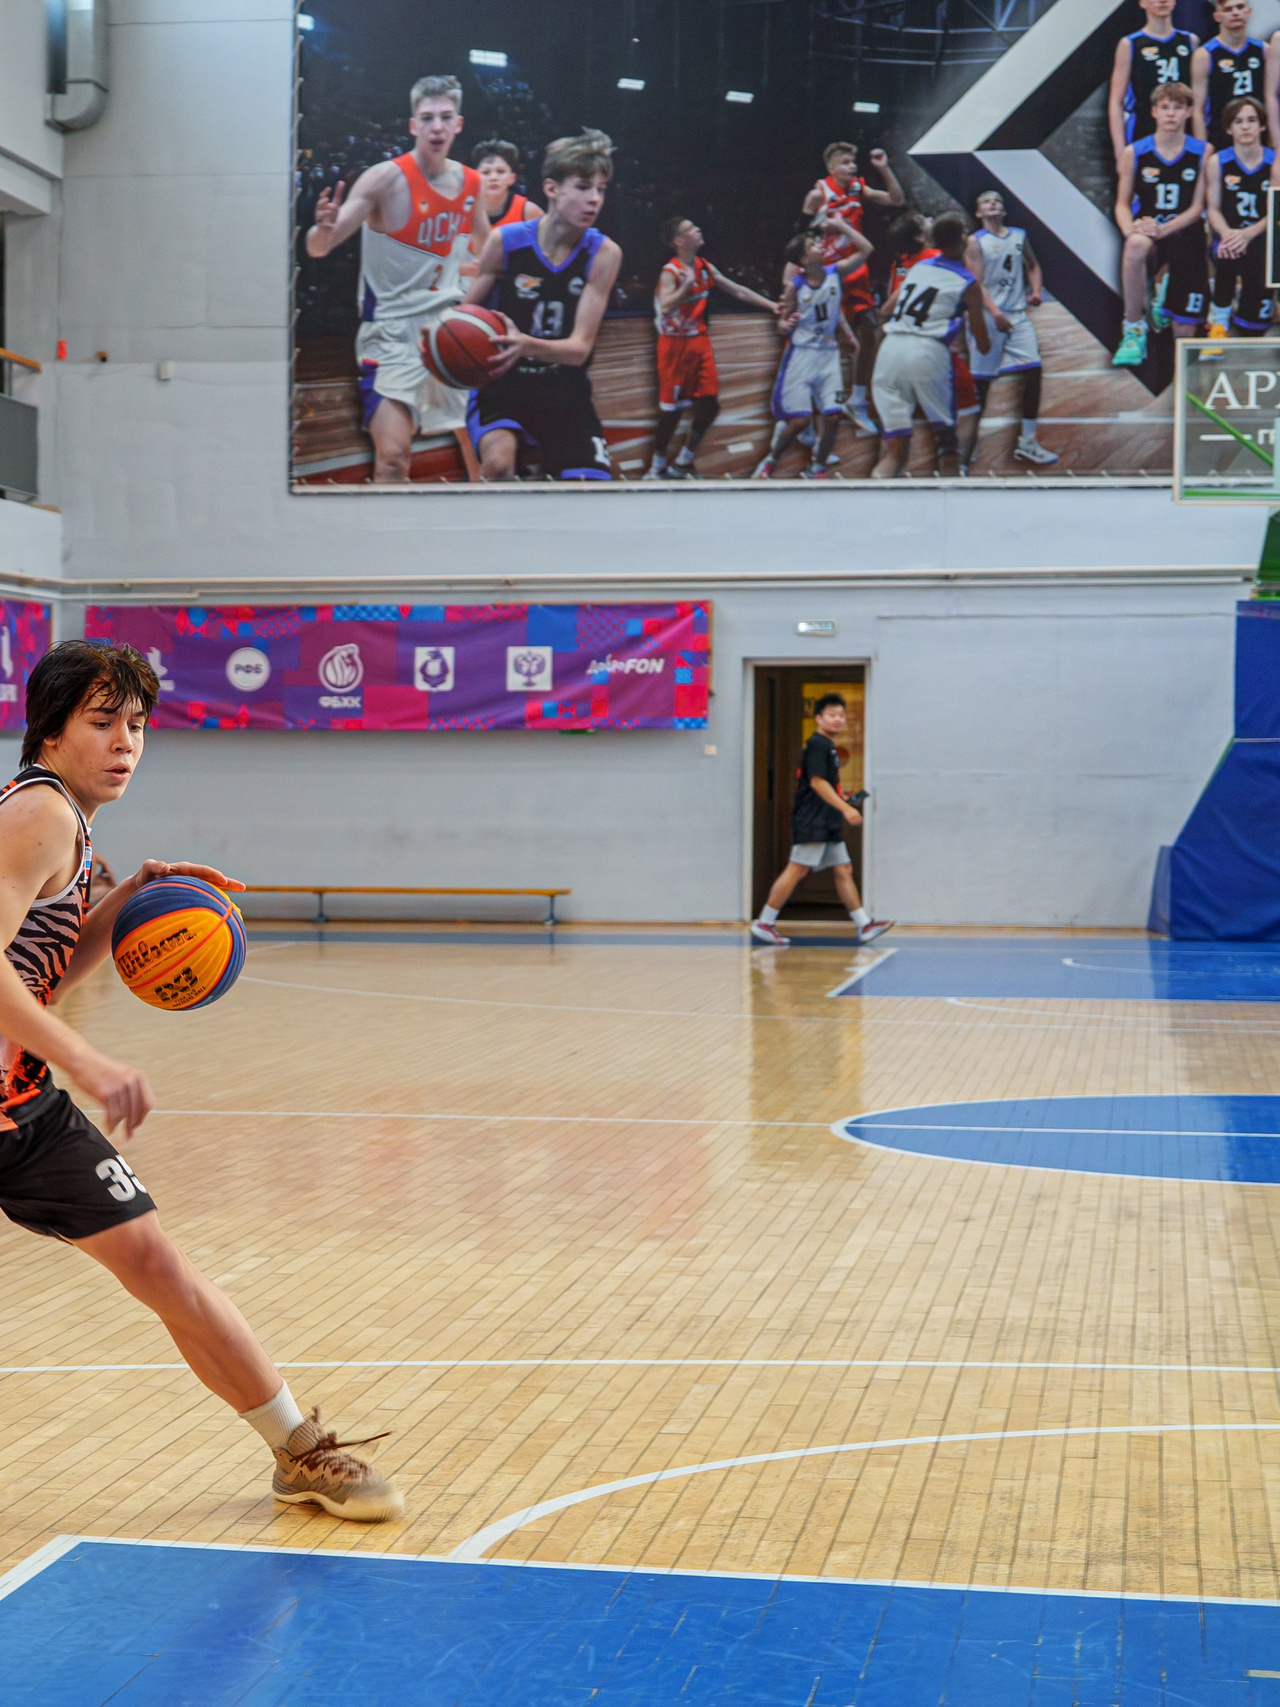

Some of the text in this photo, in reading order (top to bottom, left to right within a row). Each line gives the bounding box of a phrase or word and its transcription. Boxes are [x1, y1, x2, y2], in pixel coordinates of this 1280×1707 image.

[1155, 56, 1180, 84] 34
[1232, 69, 1254, 96] 23
[1155, 182, 1180, 211] 13
[1236, 191, 1260, 218] 21
[891, 283, 940, 328] 14
[1204, 371, 1280, 410] АР
